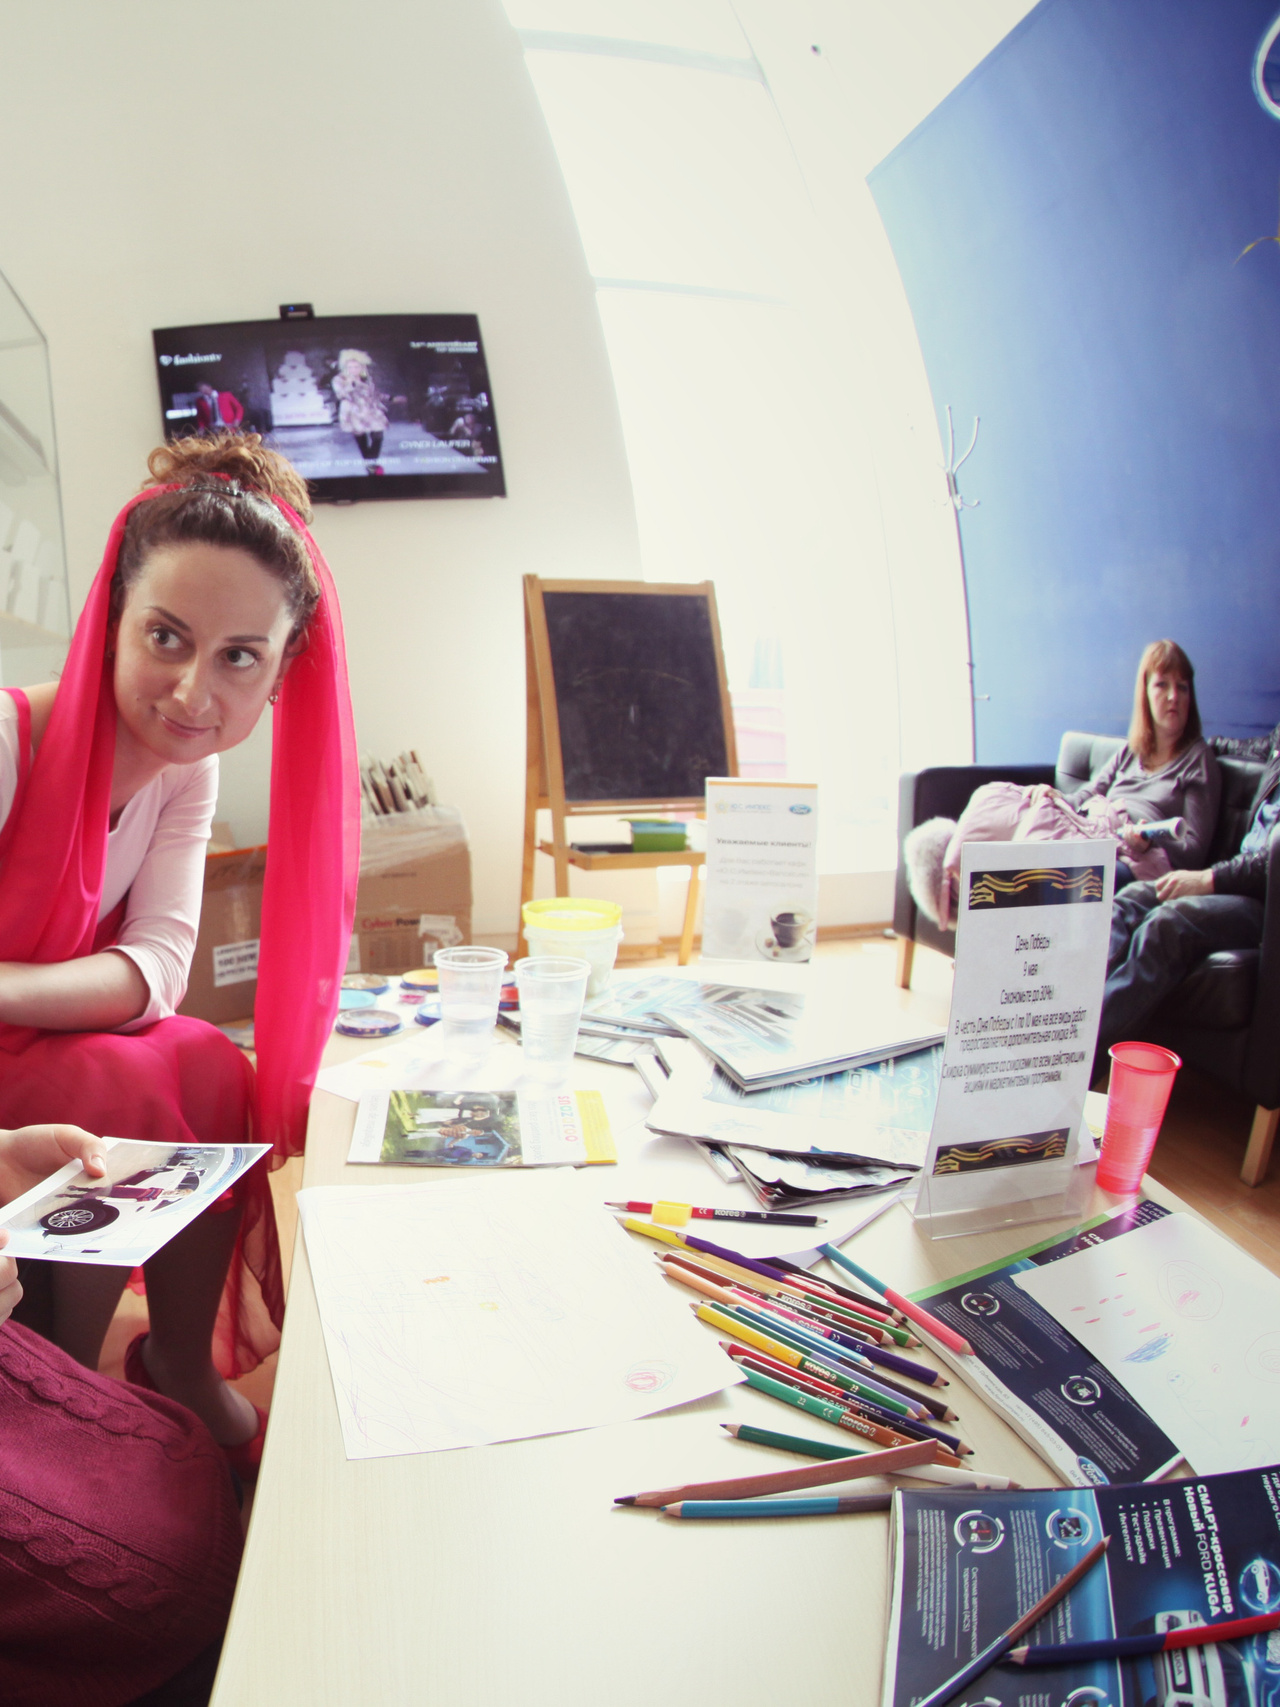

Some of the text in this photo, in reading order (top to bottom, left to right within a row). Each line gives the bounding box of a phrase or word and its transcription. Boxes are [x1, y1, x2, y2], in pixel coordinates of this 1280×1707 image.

[1014, 934, 1029, 954] День
[1028, 964, 1038, 976] мая
[1081, 1462, 1107, 1487] Ford
[1120, 1511, 1134, 1562] Интеллект
[1130, 1510, 1147, 1565] Тест-драйв
[1142, 1510, 1156, 1550] Подарки
[1154, 1507, 1172, 1569] Презентация
[1163, 1505, 1182, 1557] программе:
[1182, 1486, 1221, 1617] Новый FORD KUGA
[1196, 1484, 1234, 1614] СМАРТ-кроссовер
